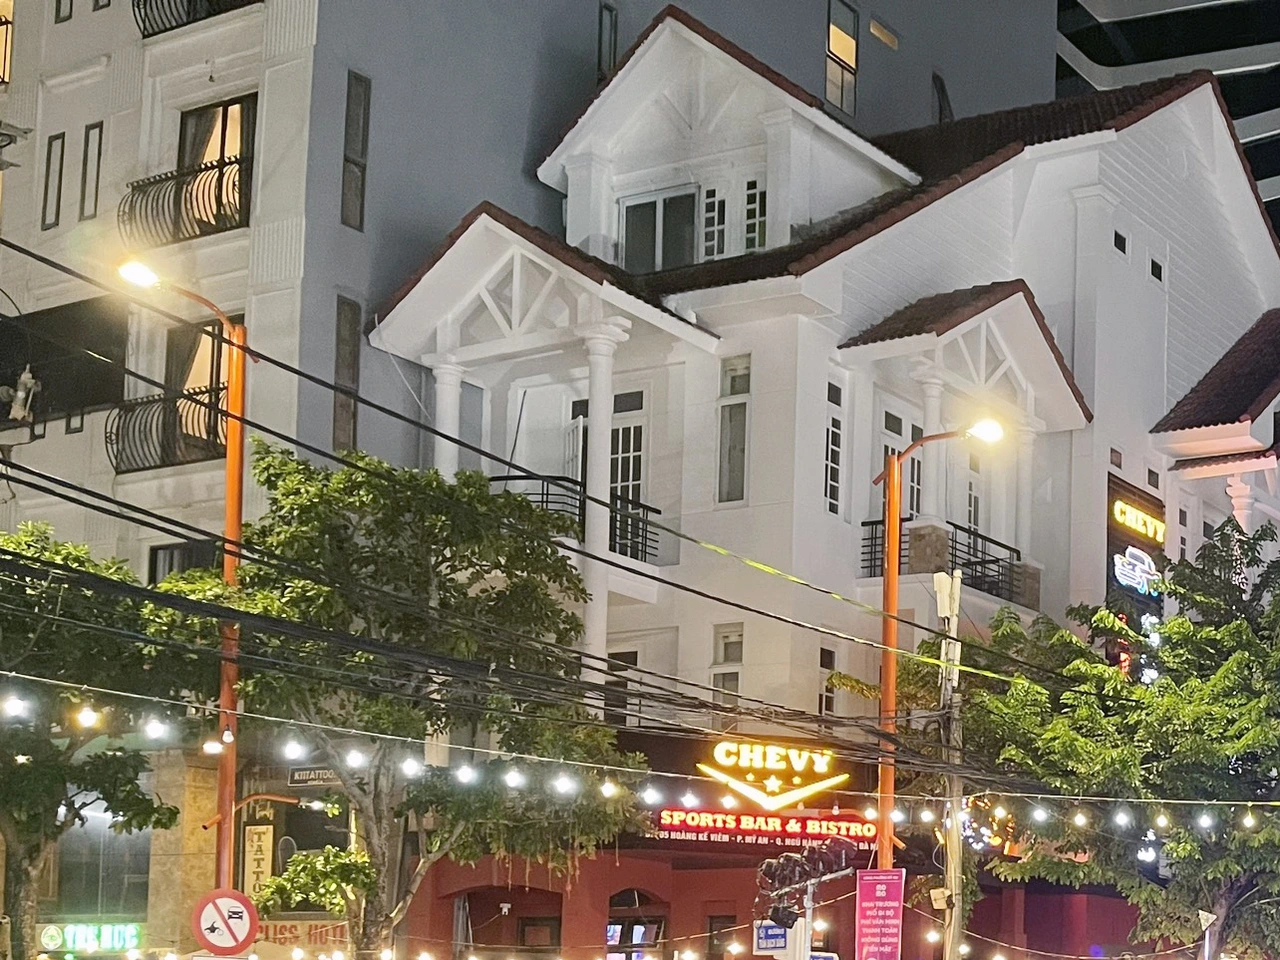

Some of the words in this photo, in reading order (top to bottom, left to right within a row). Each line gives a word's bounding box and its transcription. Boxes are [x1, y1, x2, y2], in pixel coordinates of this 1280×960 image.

[1113, 499, 1166, 544] CHEVY
[712, 741, 832, 773] CHEVY
[660, 810, 736, 829] SPORTS
[740, 814, 782, 832] BAR
[786, 819, 801, 833] &
[806, 819, 877, 837] BISTRO
